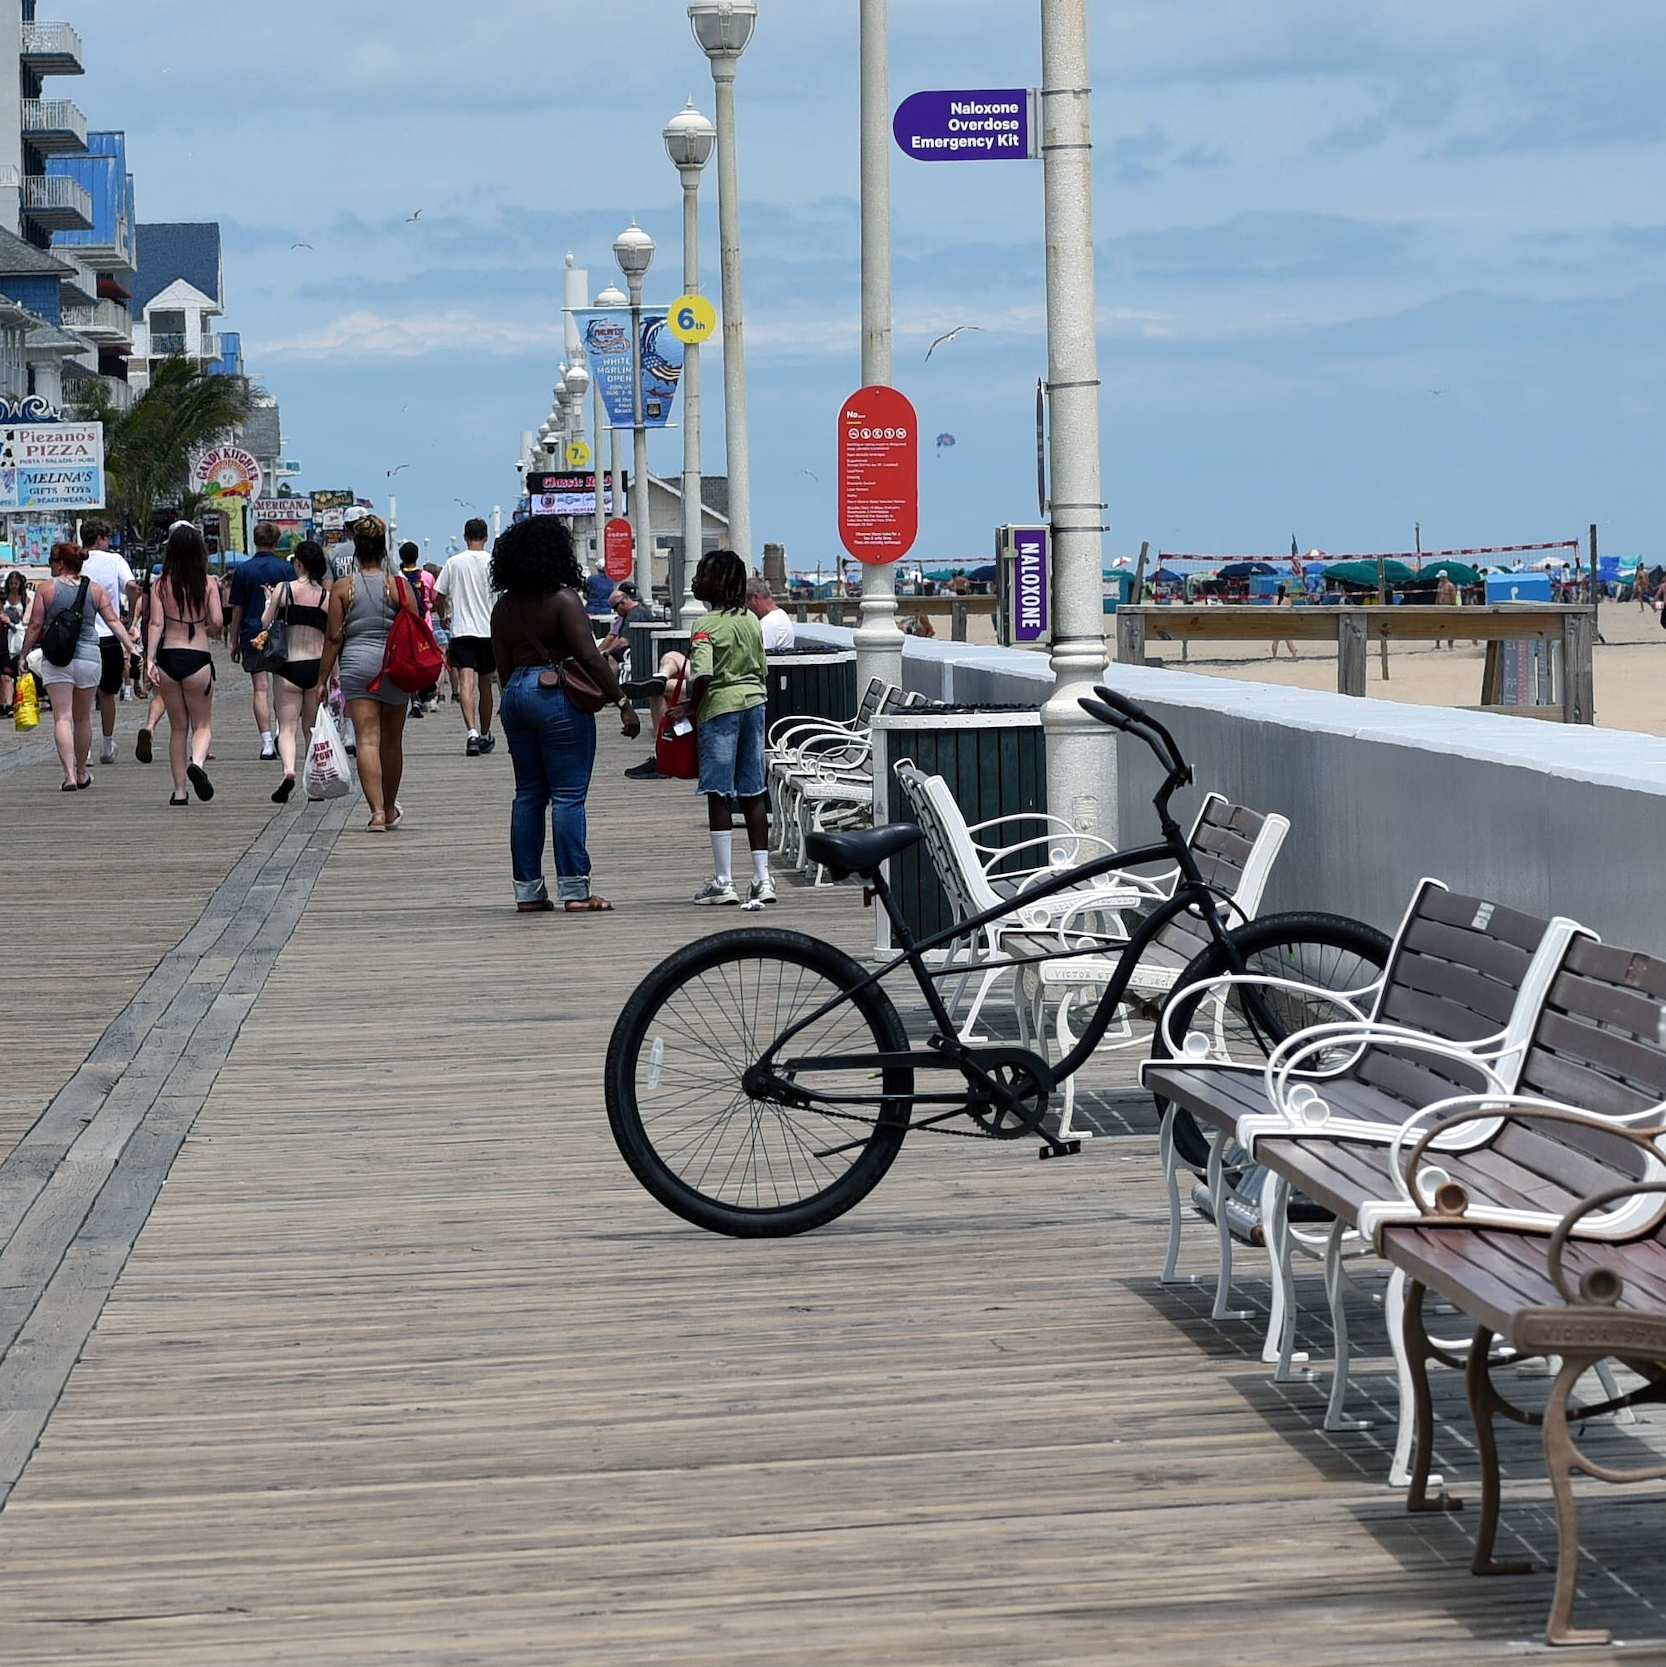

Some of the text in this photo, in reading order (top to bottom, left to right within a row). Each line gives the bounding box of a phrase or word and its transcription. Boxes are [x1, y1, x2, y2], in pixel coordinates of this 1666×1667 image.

[950, 101, 1019, 115] Naloxone
[948, 117, 1020, 131] Overdose
[911, 133, 1020, 150] Emergency Kit
[677, 307, 706, 331] 6th
[19, 428, 95, 443] Piezano's
[26, 444, 89, 457] PIZZA
[196, 447, 259, 482] CANDY KITCHEN
[24, 471, 94, 485] MELINA'S
[29, 485, 91, 495] GIFTS TOYS
[37, 496, 85, 504] BEACHWEAR
[257, 510, 303, 519] HOTEL
[1020, 542, 1041, 628] NALOXONE
